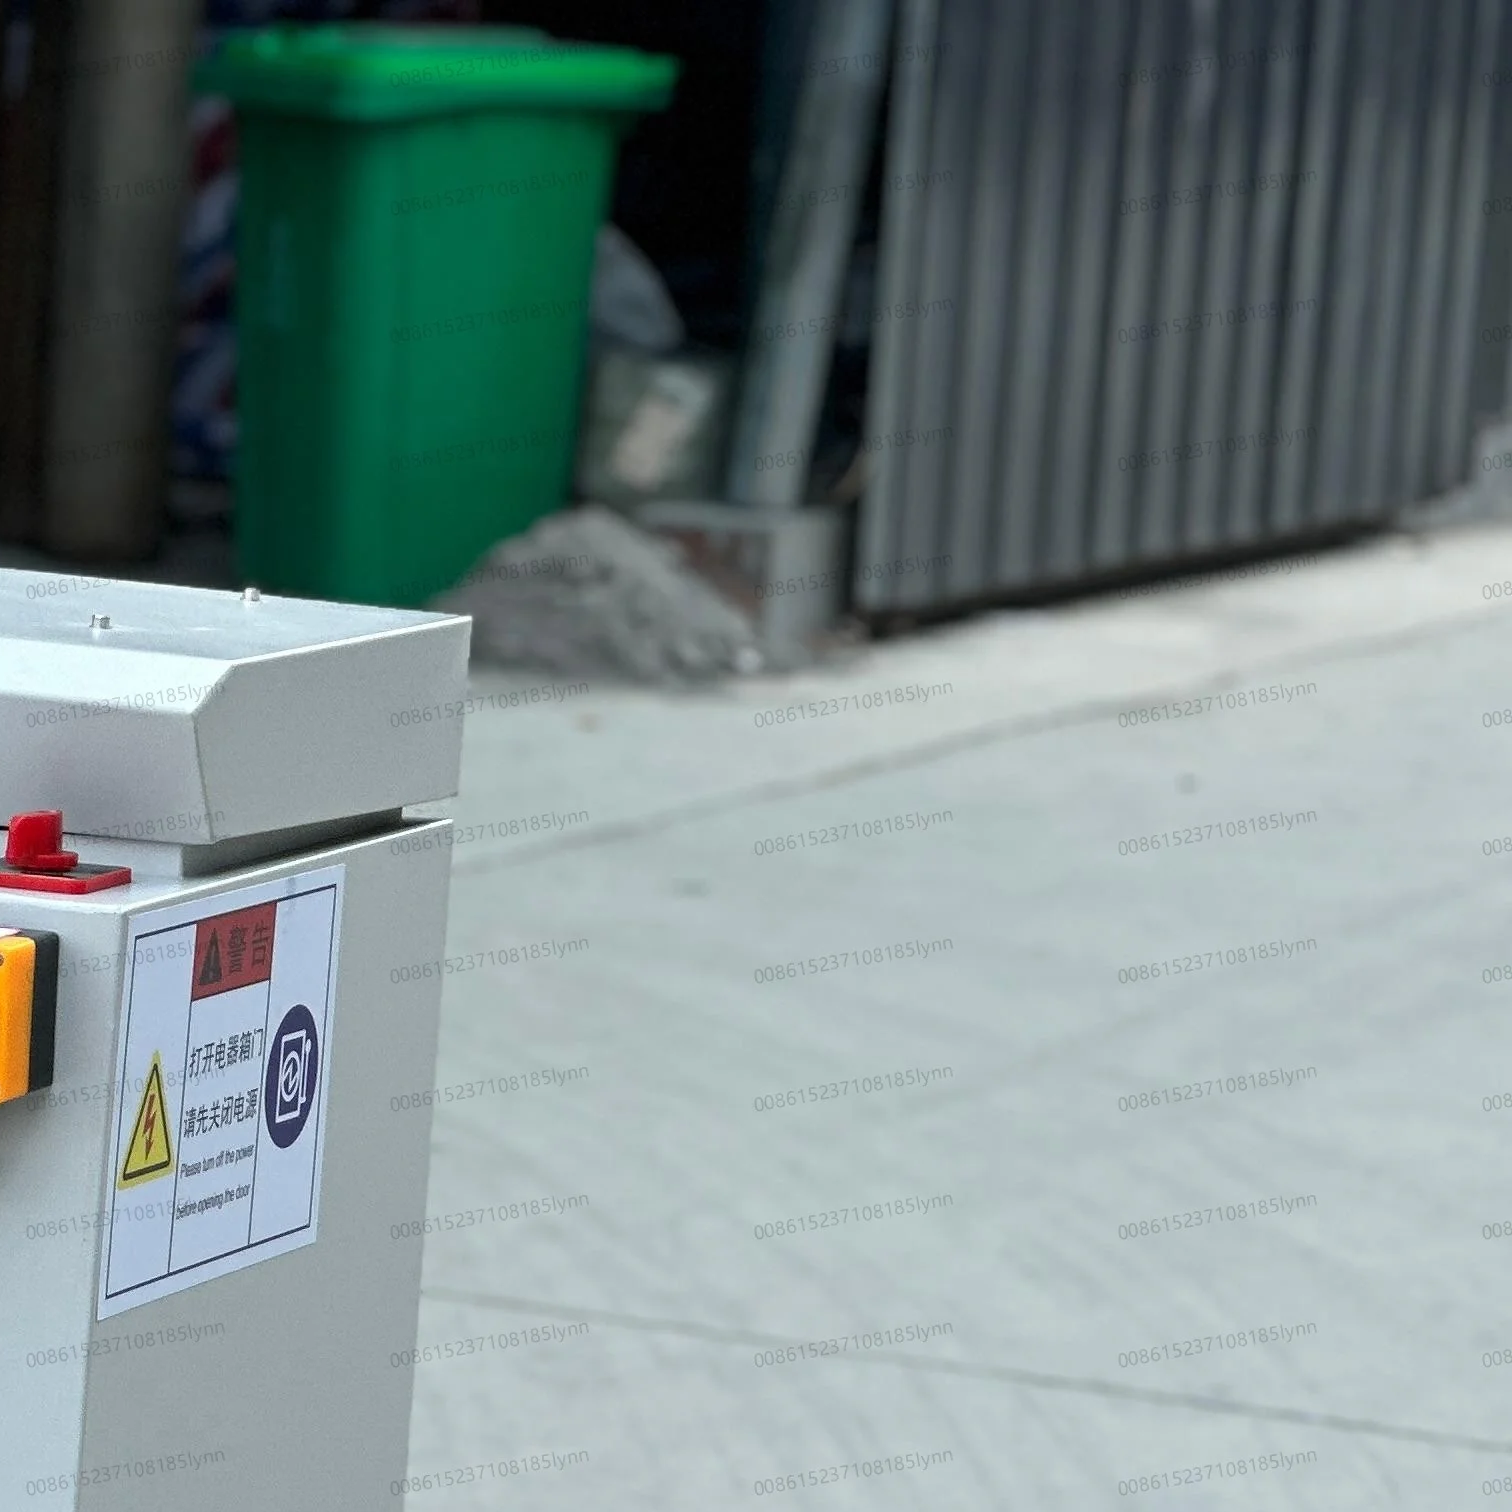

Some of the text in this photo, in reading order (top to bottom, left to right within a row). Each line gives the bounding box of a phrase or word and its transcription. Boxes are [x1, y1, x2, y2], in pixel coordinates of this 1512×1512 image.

[227, 920, 271, 974] 警告
[189, 1028, 264, 1078] 打开电器箱门
[183, 1087, 258, 1138] 请先关闭电源
[180, 1162, 201, 1178] Please
[235, 1144, 254, 1164] power
[235, 1184, 250, 1200] door
